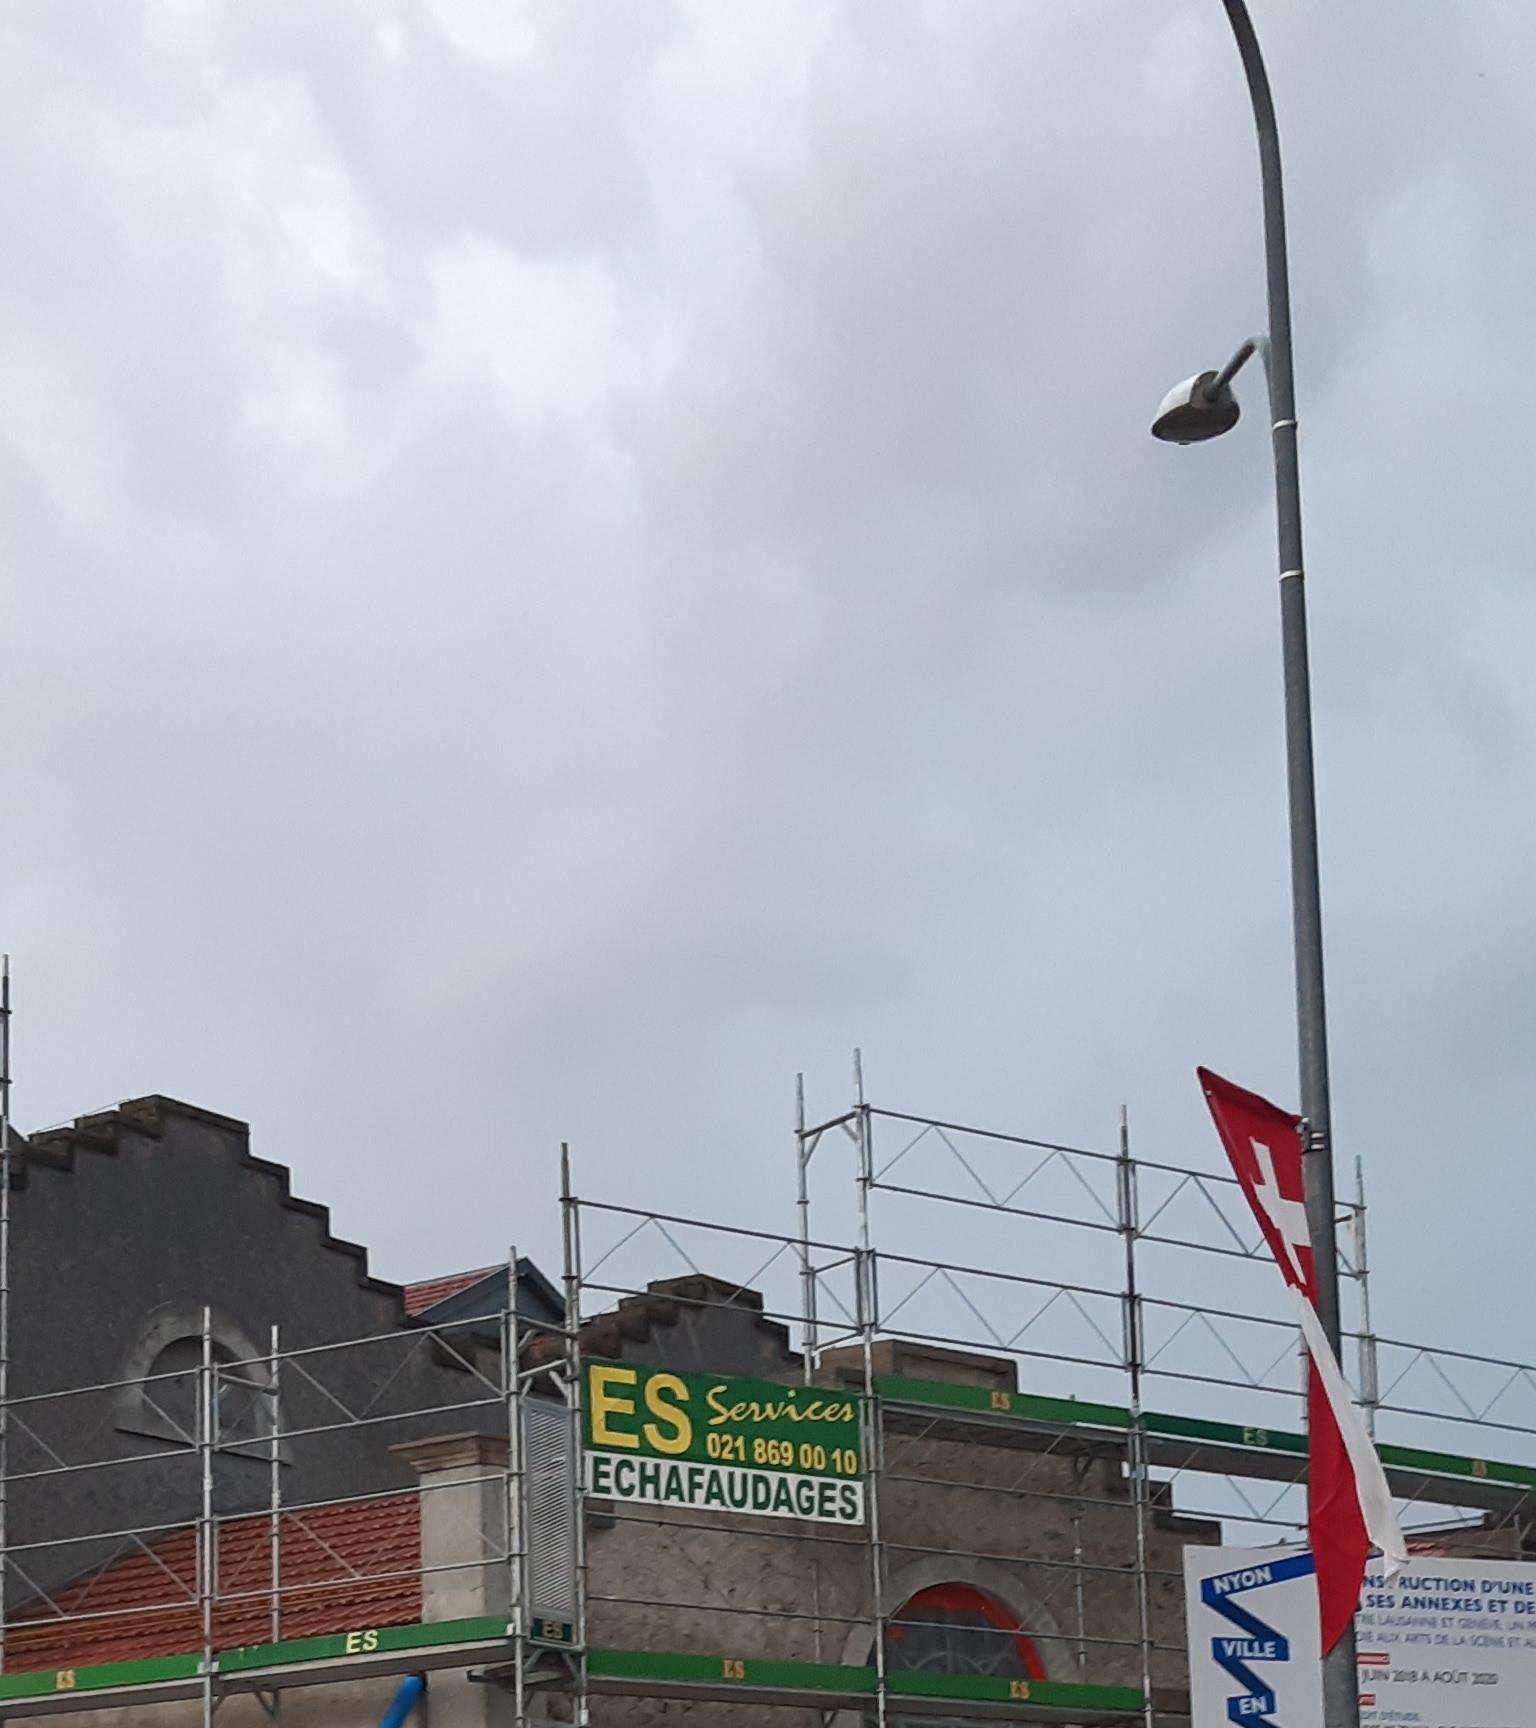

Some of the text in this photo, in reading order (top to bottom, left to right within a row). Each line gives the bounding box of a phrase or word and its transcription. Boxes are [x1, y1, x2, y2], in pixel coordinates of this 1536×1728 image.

[590, 1366, 855, 1454] ES Services
[1242, 1427, 1267, 1446] ES
[706, 1431, 858, 1475] 021 869 00 10
[591, 1457, 859, 1522] ECHAFAUDAGES
[1212, 1565, 1272, 1595] NYON
[1363, 1575, 1475, 1593] NSRUCTION
[1481, 1580, 1534, 1595] D'UNE
[1365, 1594, 1396, 1609] SES
[1400, 1596, 1484, 1613] ANNEXES
[1488, 1599, 1508, 1613] ET
[1513, 1600, 1536, 1615] DE
[543, 1620, 564, 1640] ES
[346, 1630, 379, 1653] ES
[1221, 1640, 1276, 1659] VILLE
[1238, 1696, 1268, 1715] EN
